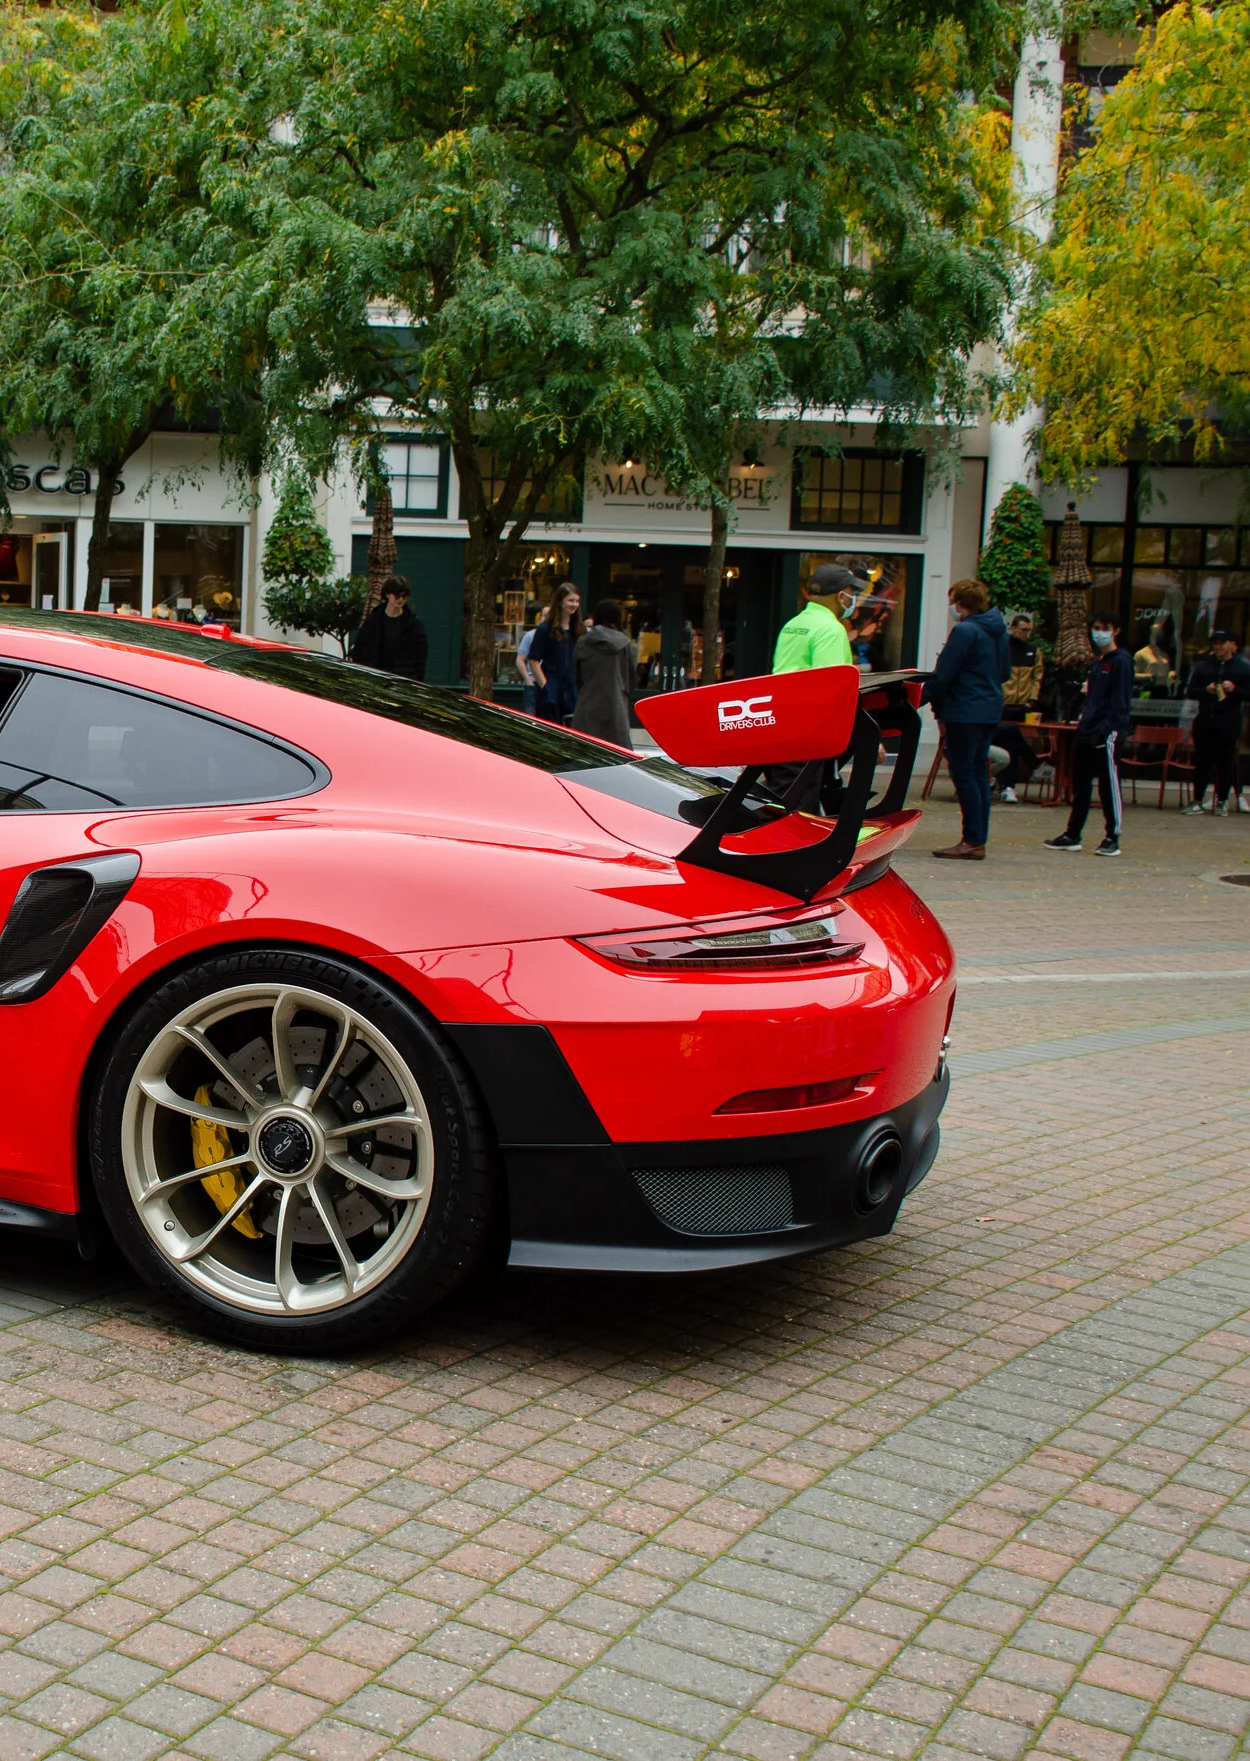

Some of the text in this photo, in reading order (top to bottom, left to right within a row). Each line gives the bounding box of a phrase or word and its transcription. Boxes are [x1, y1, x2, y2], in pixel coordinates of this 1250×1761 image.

[604, 474, 656, 496] MAC
[648, 502, 682, 511] HOME
[718, 696, 773, 722] DC
[719, 716, 776, 731] DRIVERS CLUB
[215, 953, 350, 987] MICHELIN
[273, 1135, 292, 1158] RS
